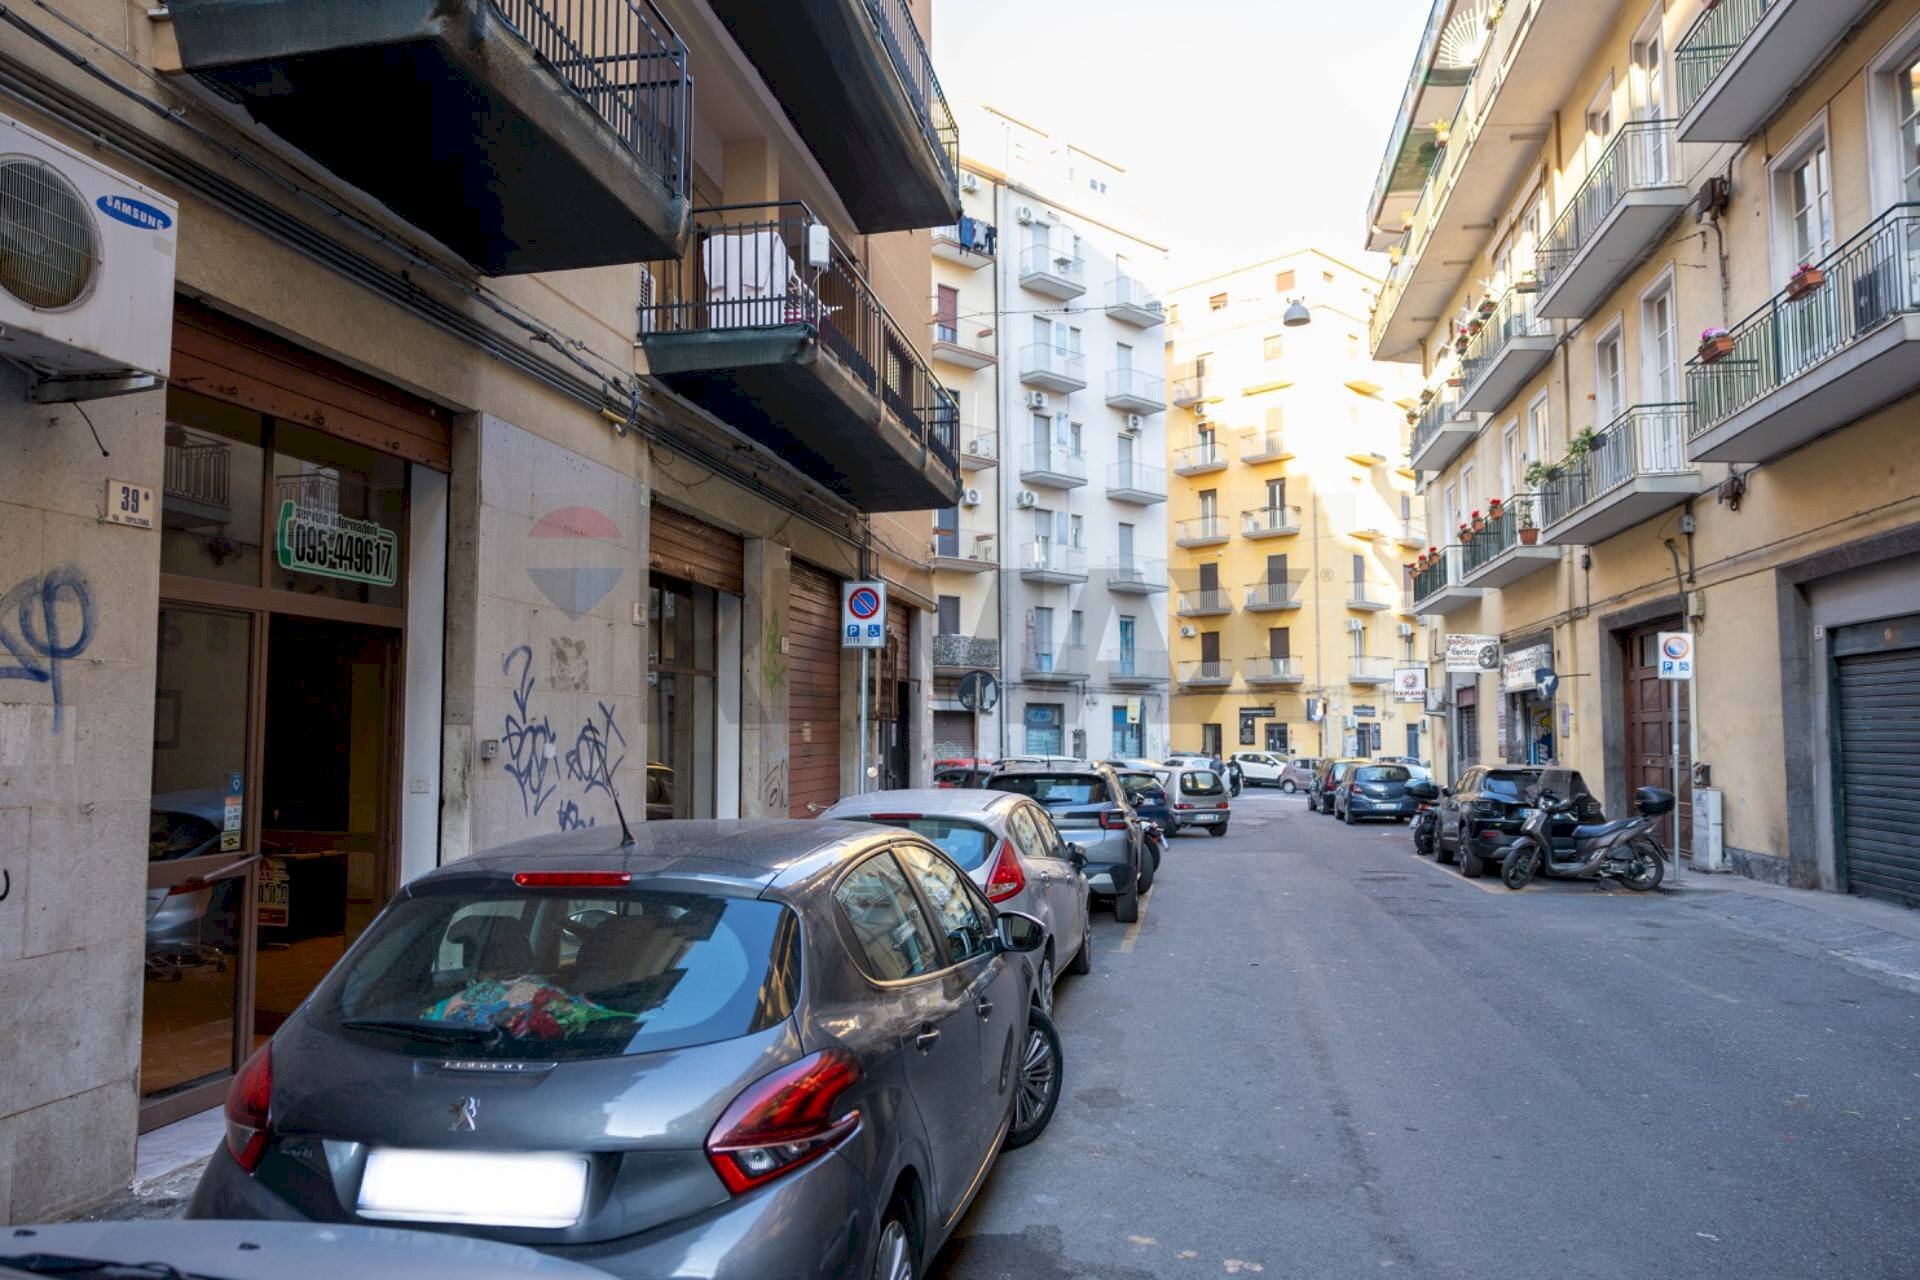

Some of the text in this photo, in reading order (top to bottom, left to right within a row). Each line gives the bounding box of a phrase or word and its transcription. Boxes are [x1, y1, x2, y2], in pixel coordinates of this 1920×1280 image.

[106, 194, 165, 231] SAMSUNG
[121, 486, 140, 513] 39
[295, 507, 379, 537] servizio informazioni
[443, 1061, 525, 1070] PEUGEOT
